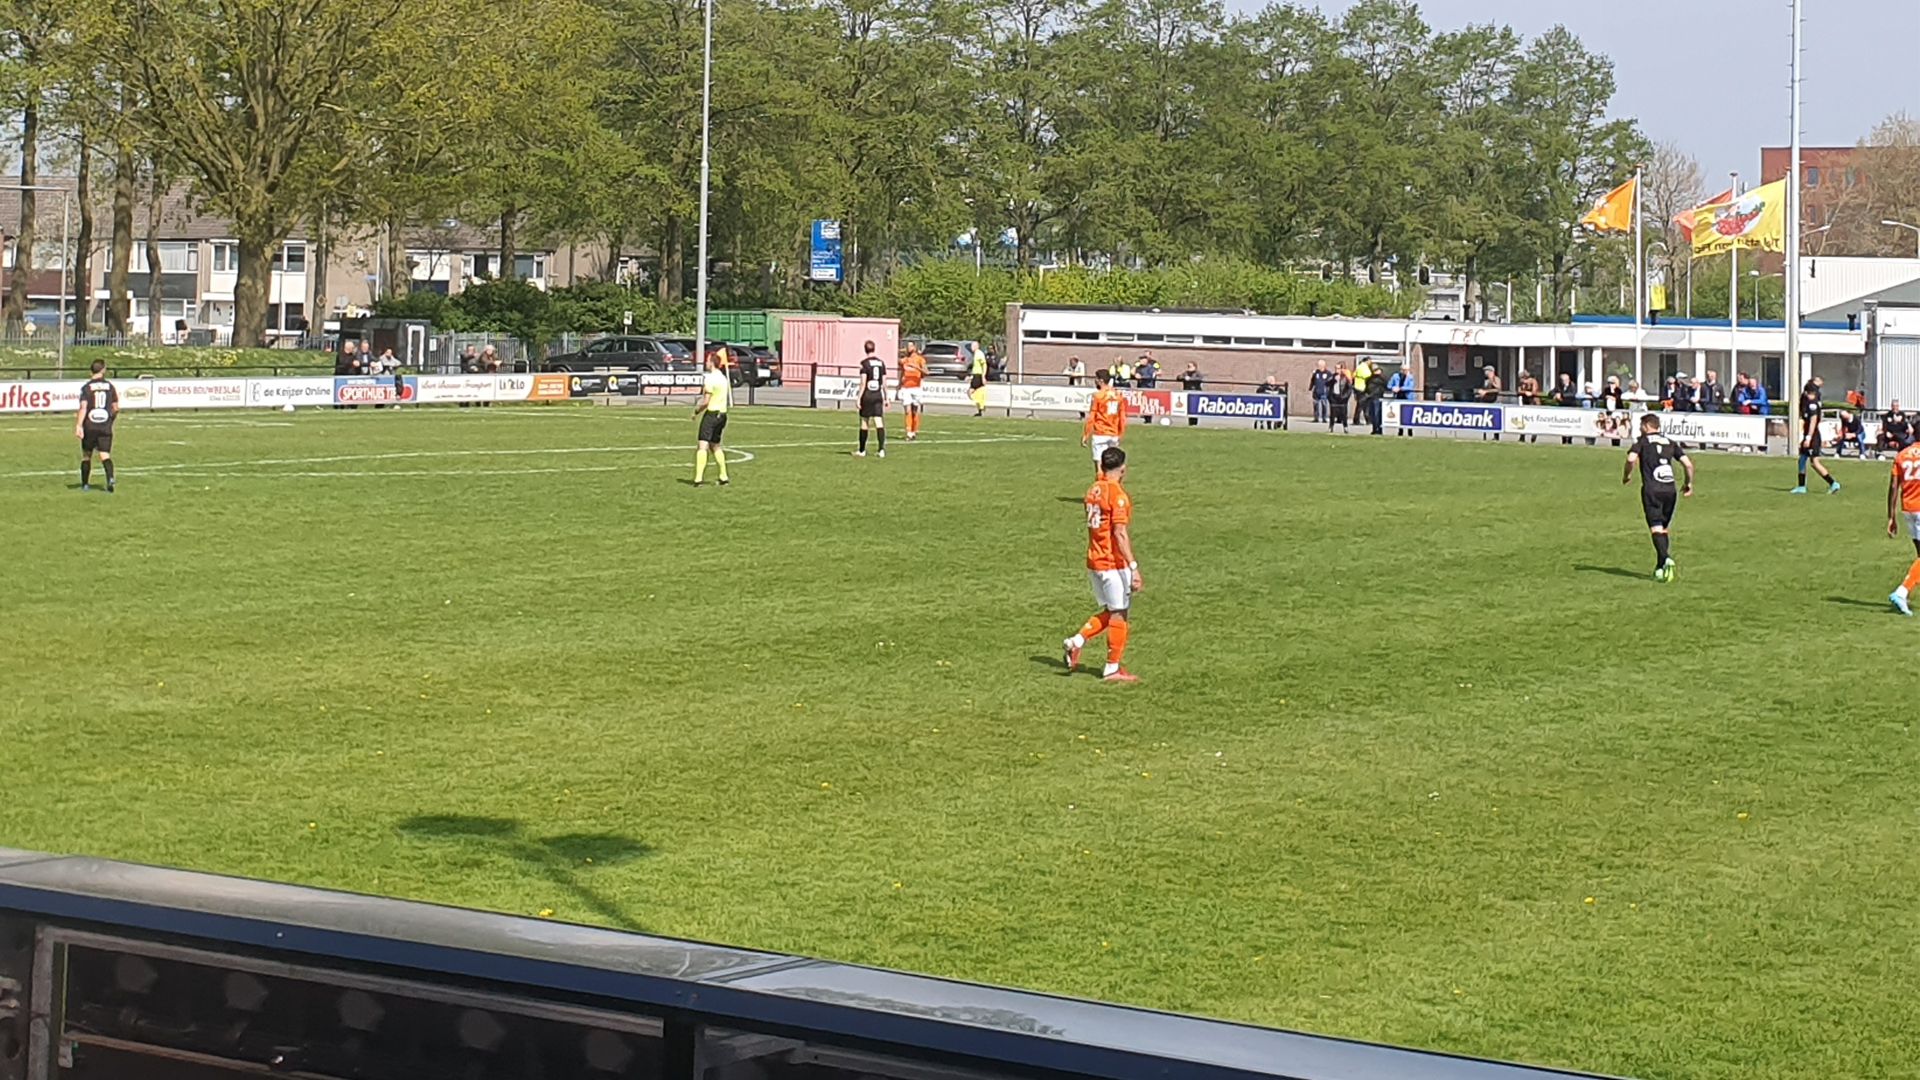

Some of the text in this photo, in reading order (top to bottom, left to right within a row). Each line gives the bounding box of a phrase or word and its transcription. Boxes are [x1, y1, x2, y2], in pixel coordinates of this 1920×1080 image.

[94, 390, 106, 408] 10
[264, 388, 274, 397] de
[305, 386, 330, 396] Online
[1197, 396, 1273, 416] Rabobank
[1411, 406, 1494, 428] Rabobank
